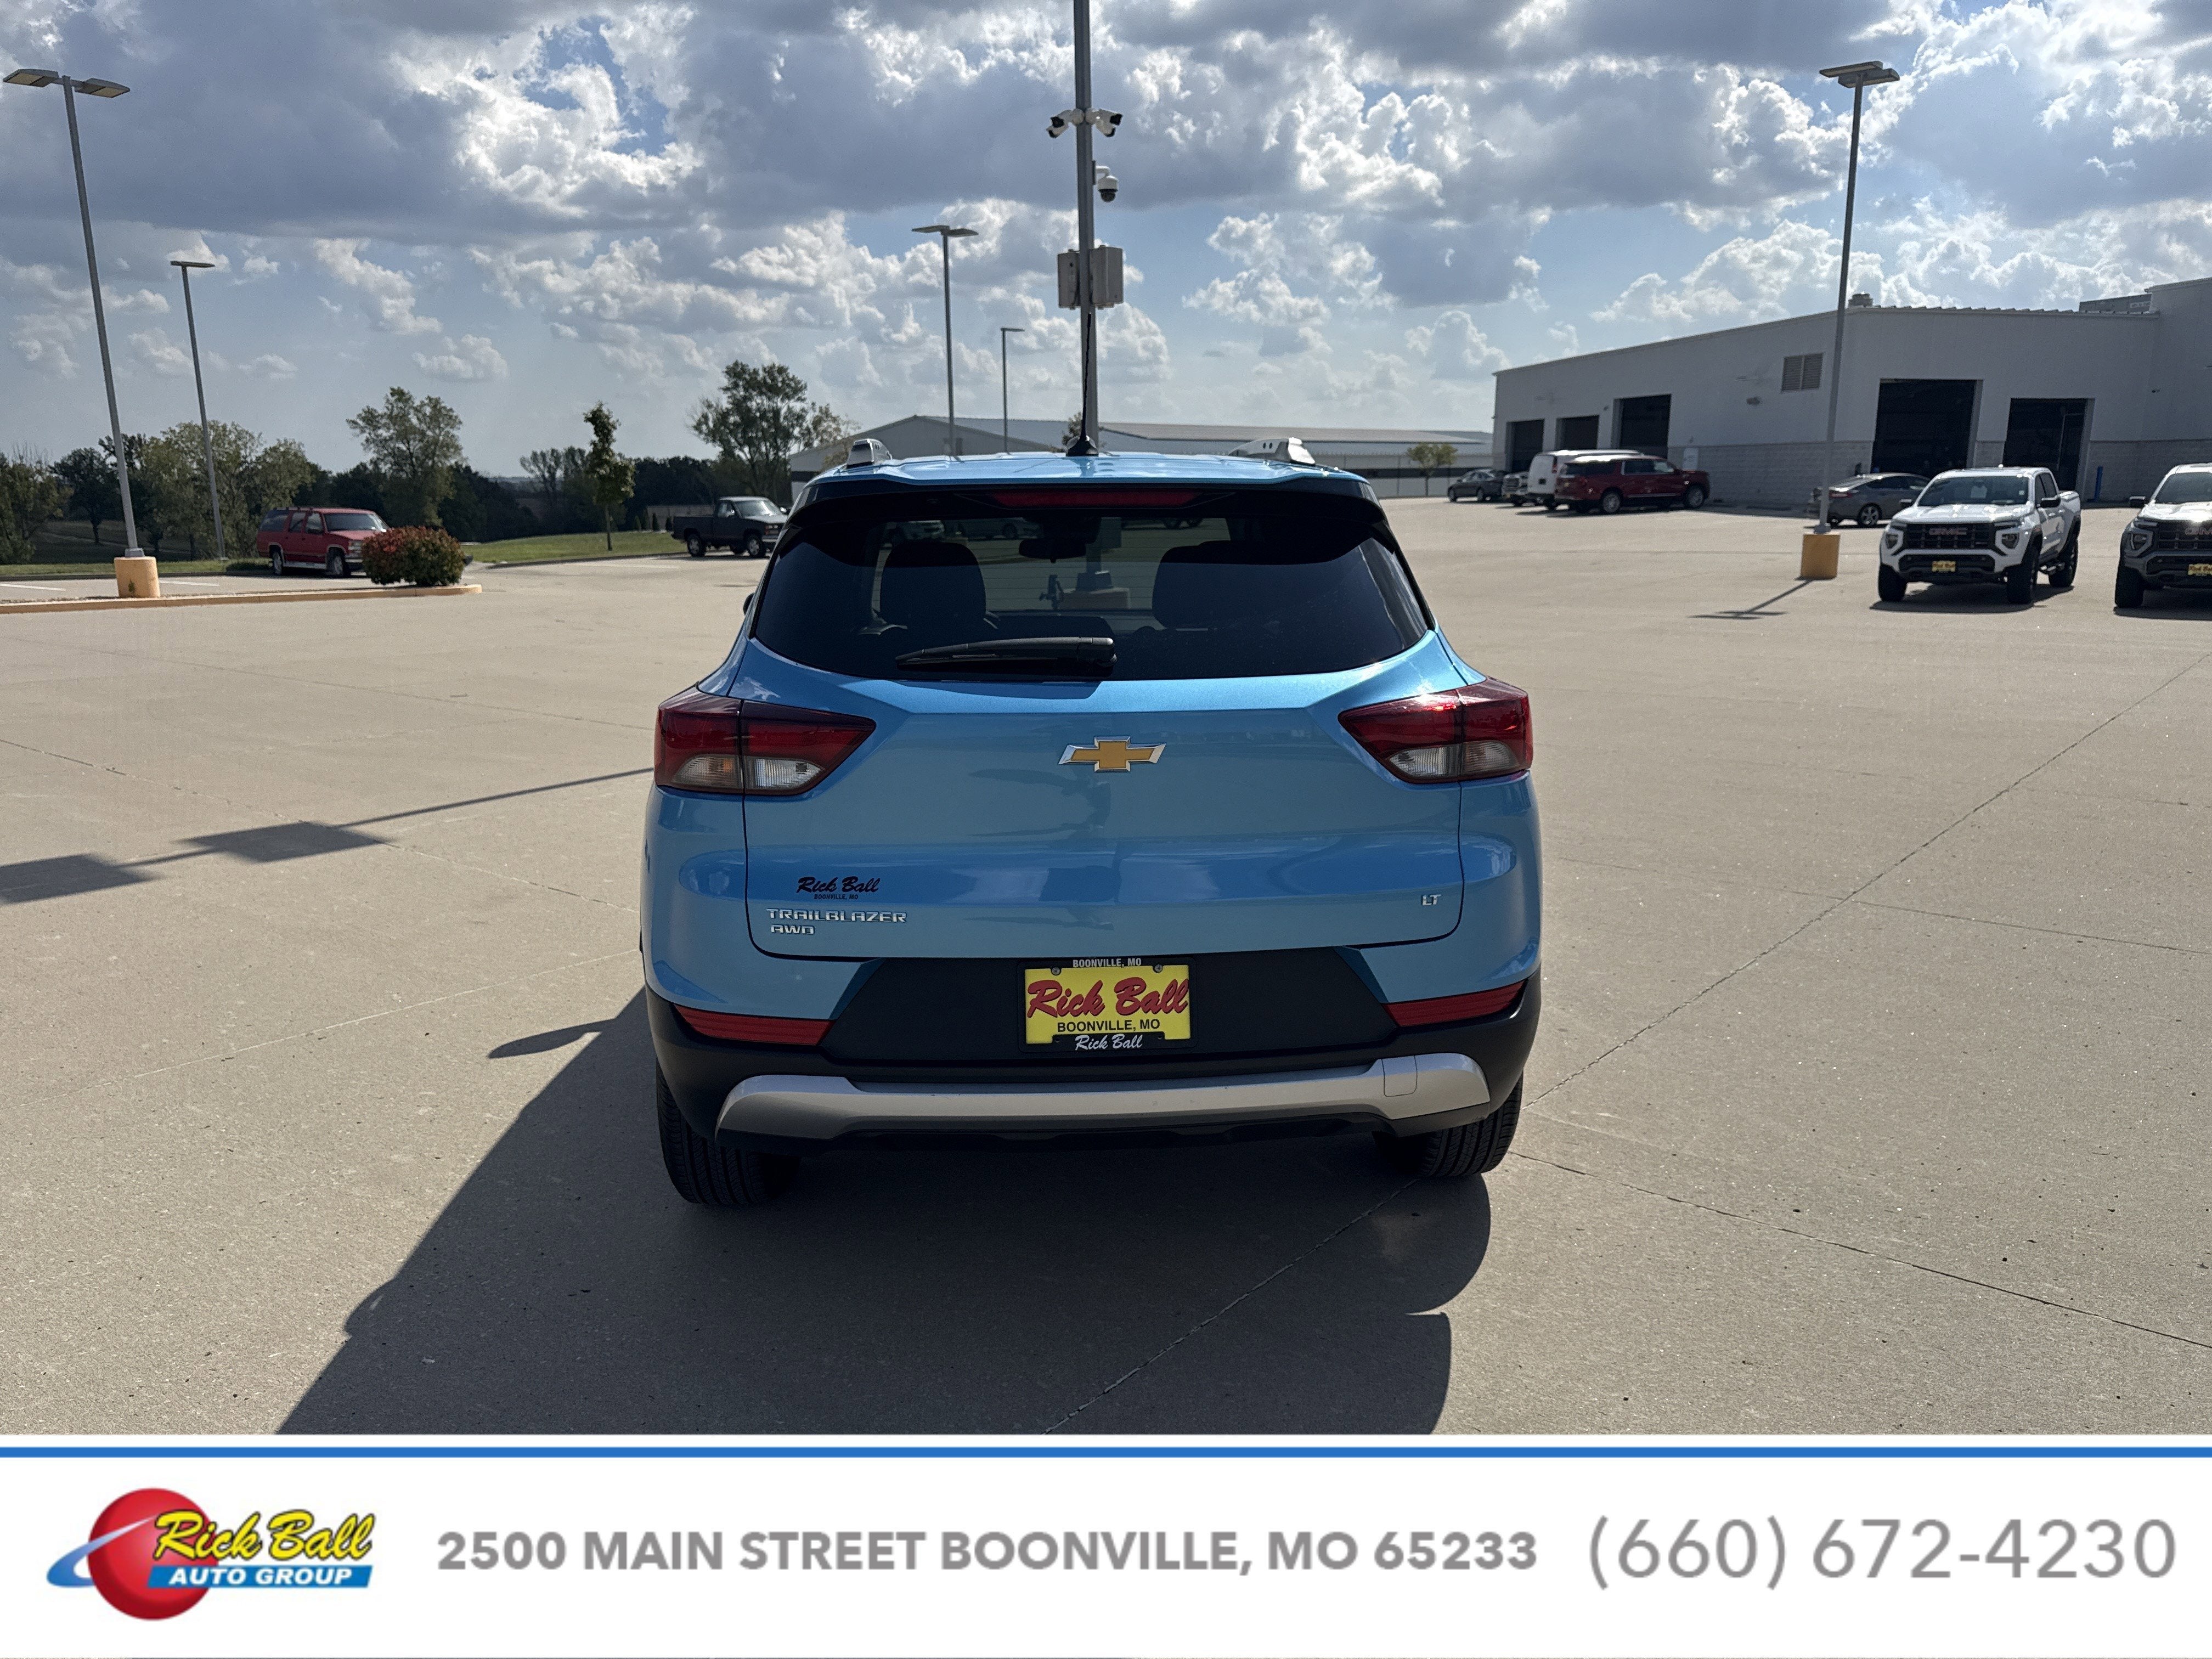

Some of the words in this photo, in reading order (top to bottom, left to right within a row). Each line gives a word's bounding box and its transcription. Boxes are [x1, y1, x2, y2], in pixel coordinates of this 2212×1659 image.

[796, 876, 838, 893] Rick
[842, 876, 881, 893] Ball
[1422, 894, 1441, 906] LT
[766, 908, 907, 923] TRAILBLAZER
[770, 924, 815, 934] AWD
[1073, 958, 1125, 968] BOONVILLE,
[1127, 958, 1142, 967] MO
[1027, 979, 1105, 1018] Rick
[1114, 977, 1189, 1015] Ball
[1057, 1019, 1137, 1032] BOONVILLE,
[1139, 1019, 1160, 1030] MO
[1075, 1034, 1108, 1051] Rick
[1111, 1033, 1143, 1049] Ball
